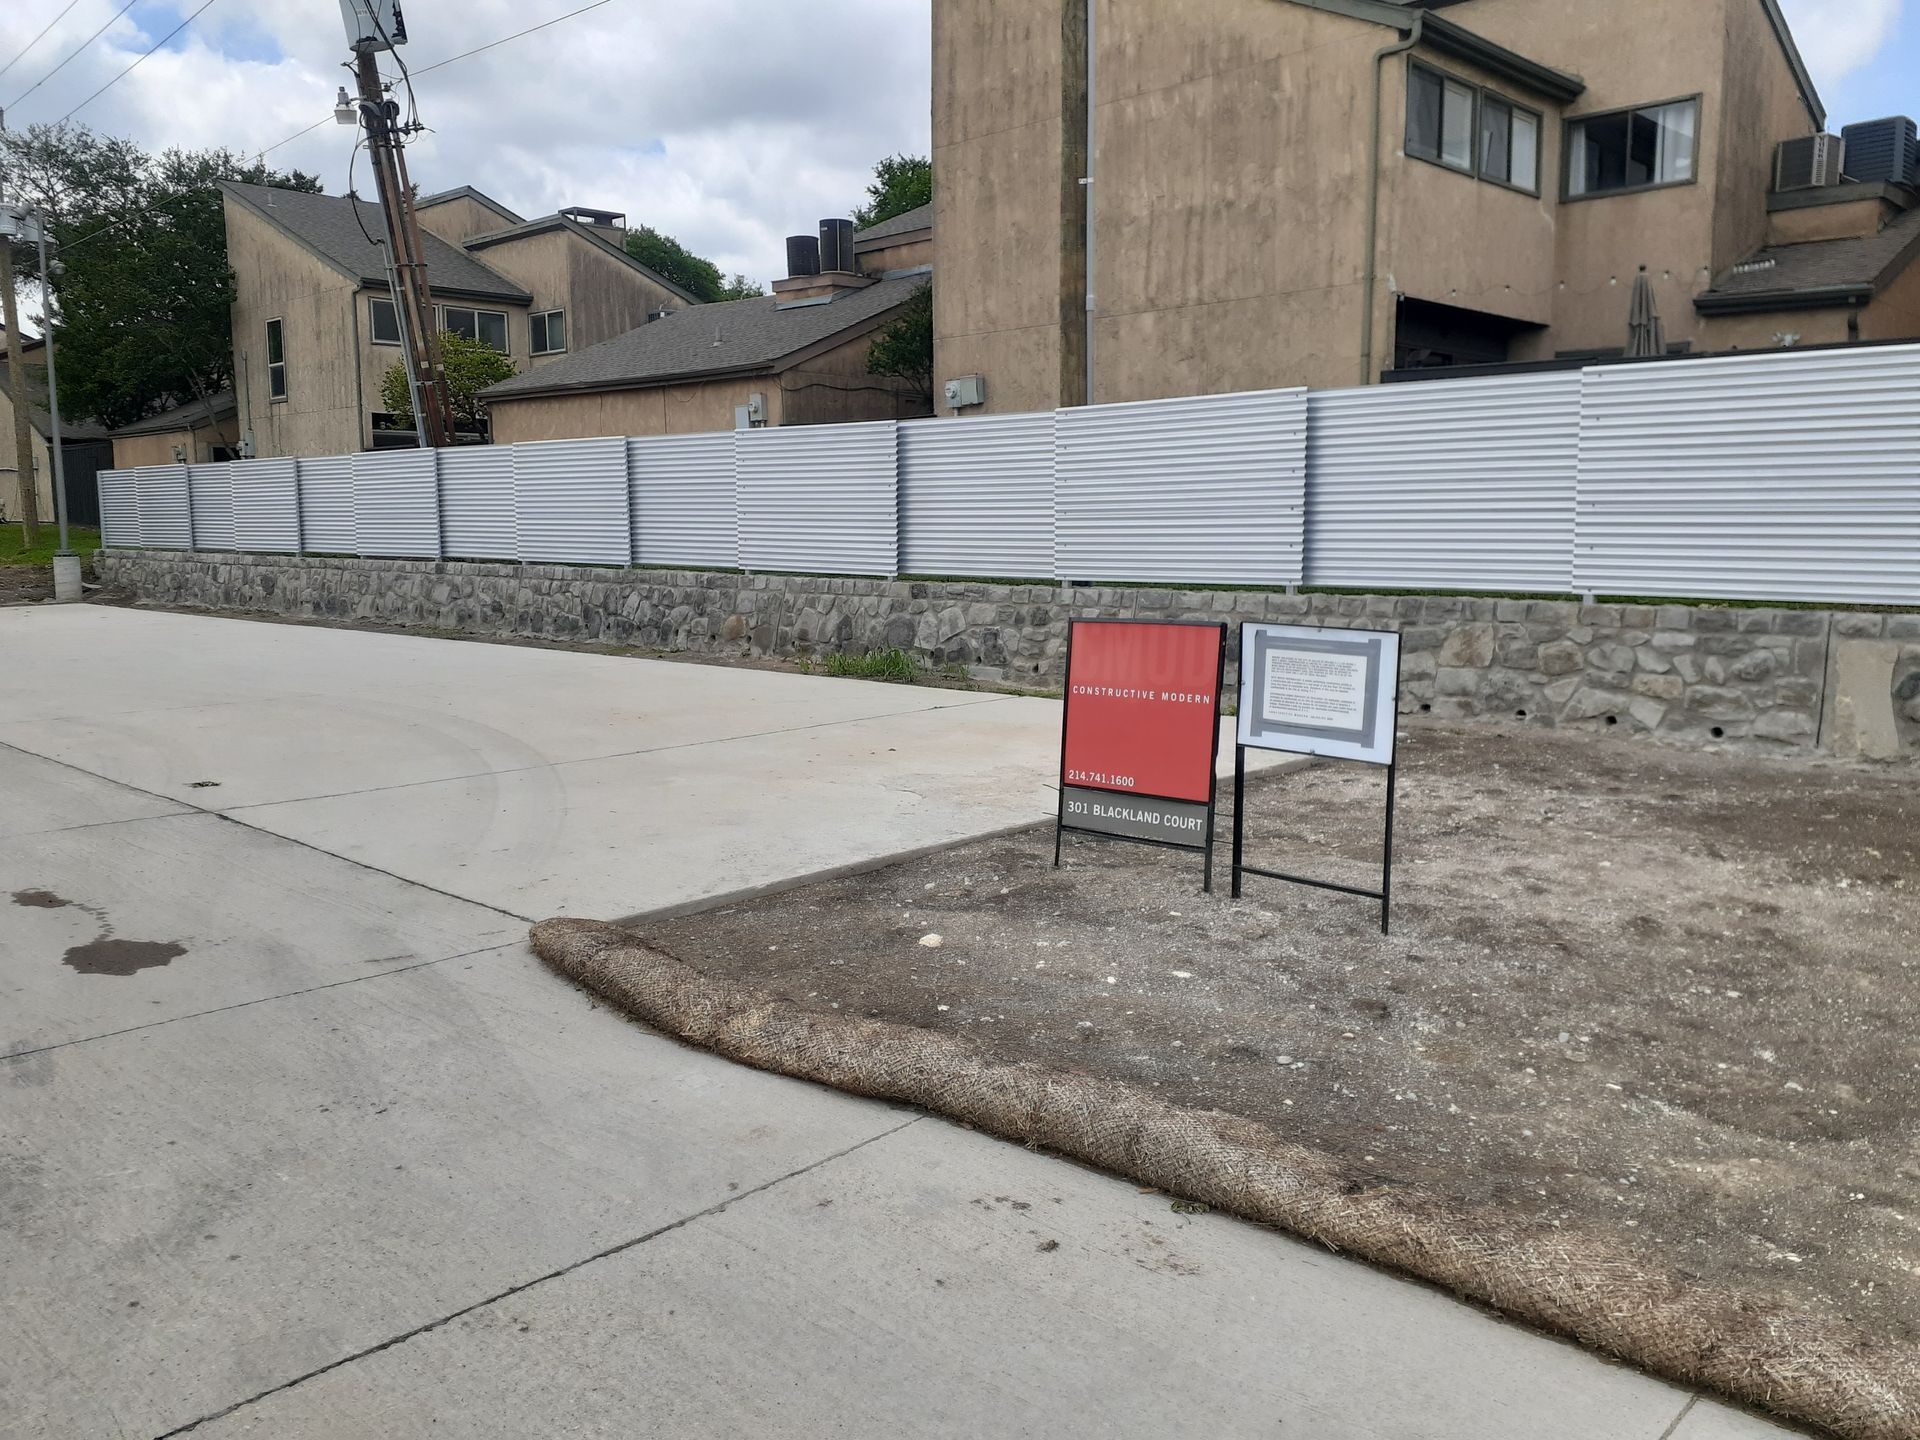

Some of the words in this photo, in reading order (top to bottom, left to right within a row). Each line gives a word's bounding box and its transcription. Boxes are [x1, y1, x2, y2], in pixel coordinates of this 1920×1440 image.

[1072, 685, 1155, 701] CONSTRUCTIVE
[1161, 691, 1211, 705] MODERN
[1068, 769, 1135, 787] 214.741.1600
[1067, 801, 1089, 815] 301
[1093, 804, 1160, 825] BLACKLAND
[1163, 814, 1203, 832] COURT
